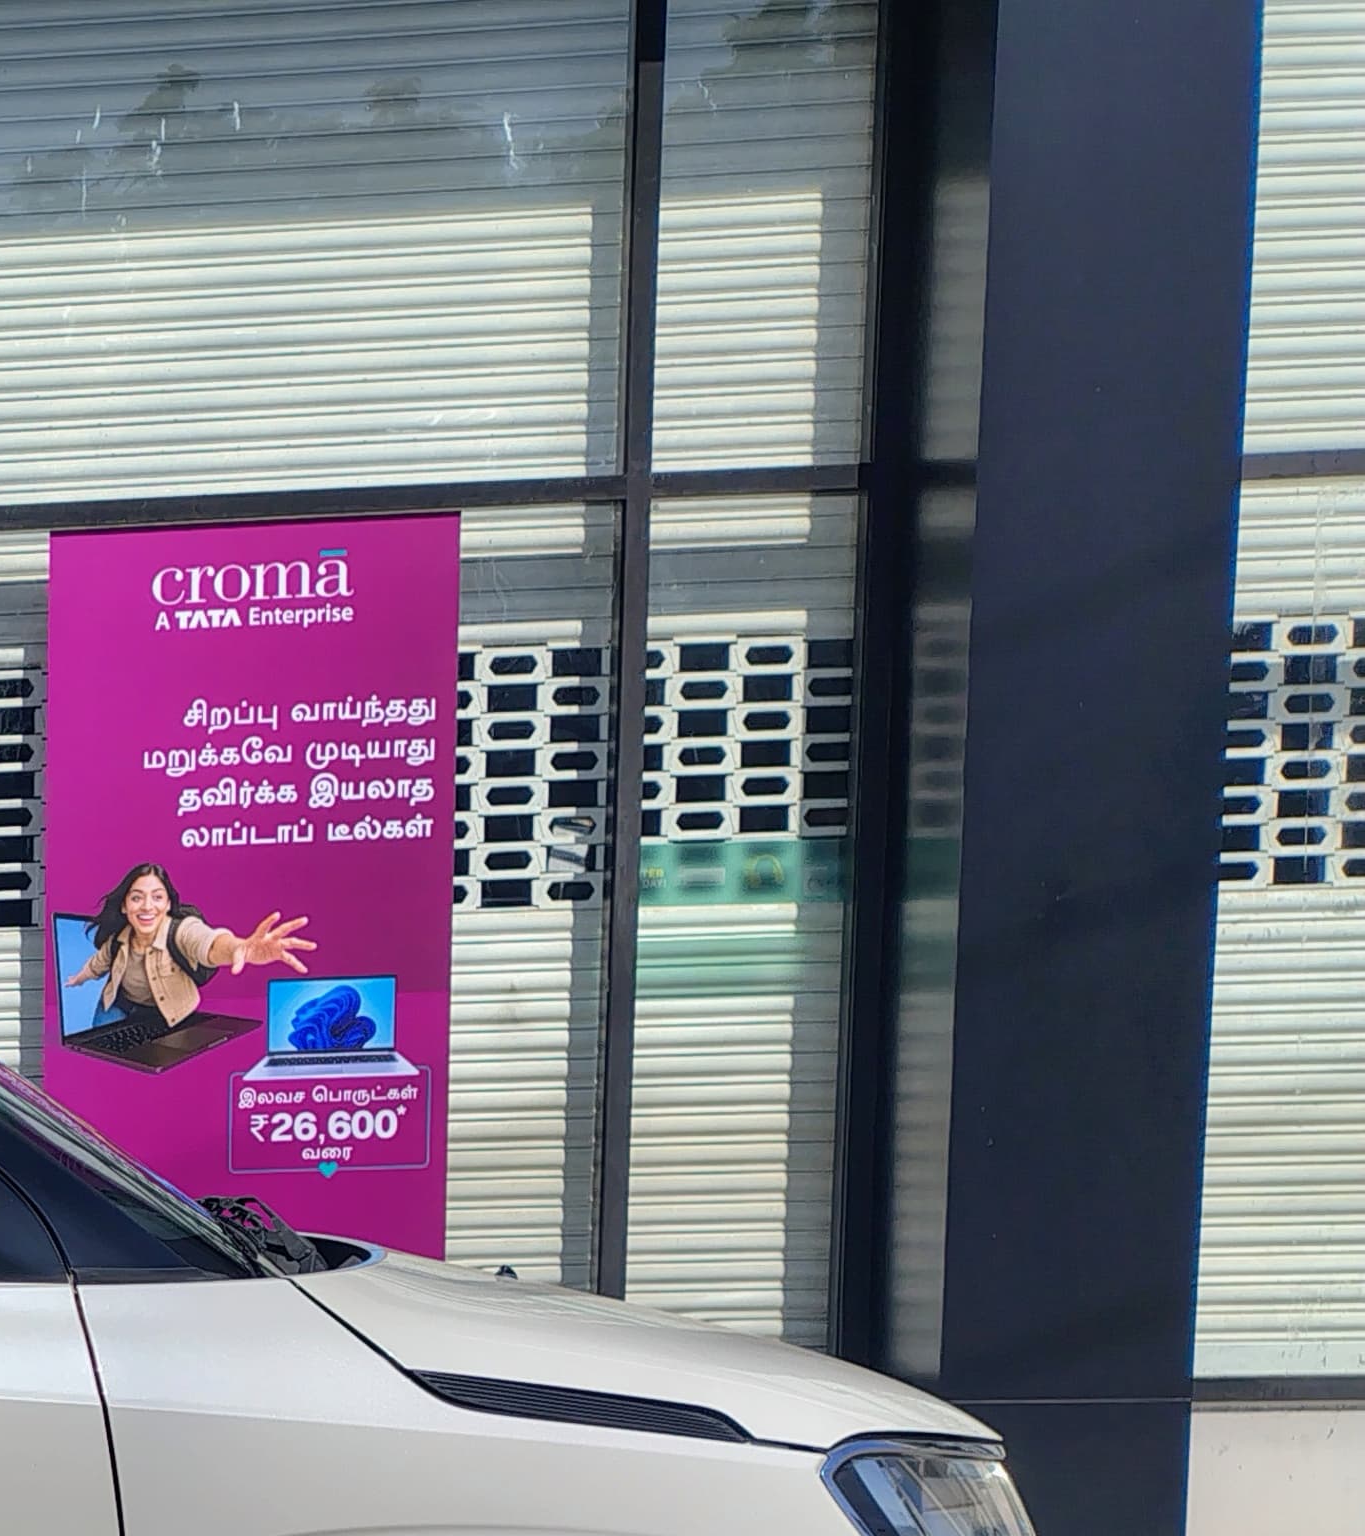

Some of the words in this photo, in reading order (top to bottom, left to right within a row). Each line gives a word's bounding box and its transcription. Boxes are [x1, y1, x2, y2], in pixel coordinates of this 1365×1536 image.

[154, 611, 171, 632] A
[174, 607, 242, 630] TATA
[248, 603, 354, 628] Enterprise
[182, 698, 279, 735] சிறப்பு
[290, 694, 437, 728] வாய்ந்தது
[142, 736, 293, 779] மறுக்கவே
[305, 737, 436, 771] முடியாது
[176, 776, 298, 816] தவிர்க்க
[308, 772, 435, 809] இயலாத
[181, 818, 314, 848] லாப்டாப்
[327, 812, 434, 842] டீல்கள்
[237, 1086, 306, 1110] இலவச
[311, 1083, 418, 1109] பொருட்கள்
[301, 1146, 353, 1164] வரை
